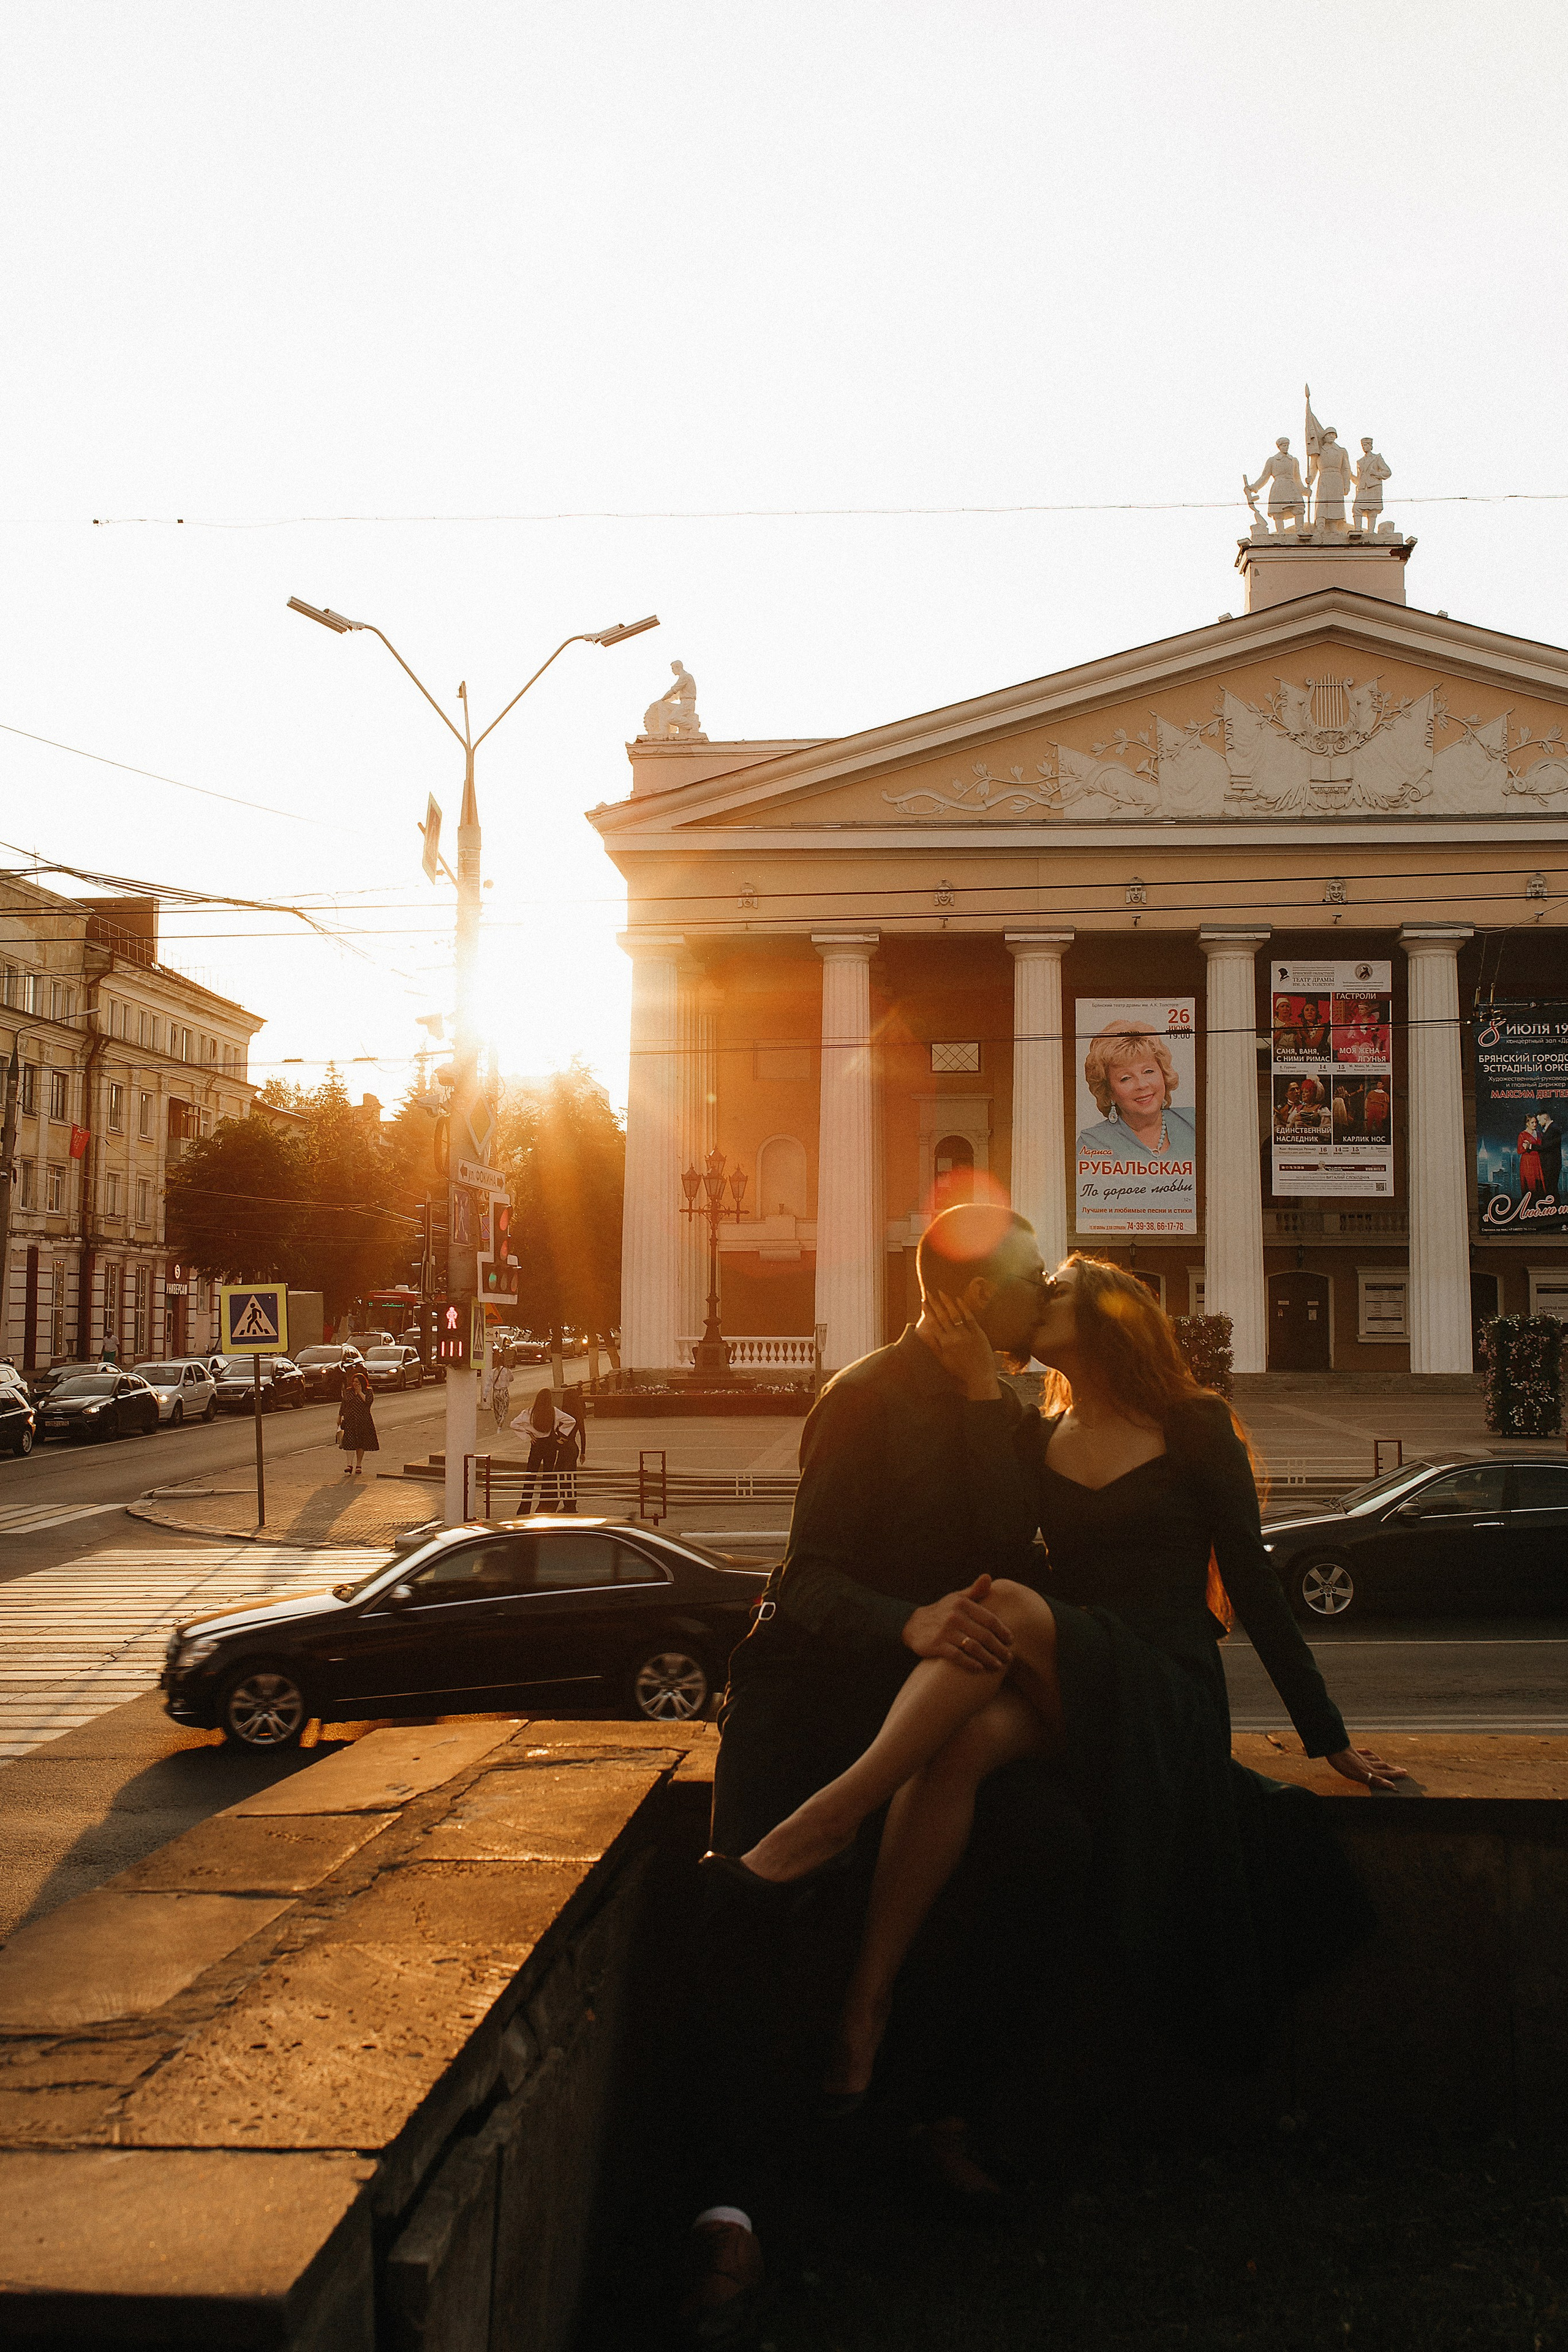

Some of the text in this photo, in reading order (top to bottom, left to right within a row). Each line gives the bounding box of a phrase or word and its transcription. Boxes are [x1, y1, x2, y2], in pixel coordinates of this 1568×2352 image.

[1168, 1009, 1190, 1023] 26
[1506, 1023, 1550, 1035] ИЮЛЯ
[1479, 1053, 1530, 1063] БРЯНСКИЙ
[1483, 1062, 1542, 1073] ЭСТРАДНЫЙ
[1490, 1090, 1535, 1099] МАКСИМ
[1079, 1145, 1112, 1158] Лариса
[1079, 1161, 1193, 1175] РУБАЛЬСКАЯ
[475, 1170, 497, 1187] ФОКИНА
[1080, 1178, 1193, 1200] По дороге любви
[1127, 1222, 1156, 1231] 74-39-38,
[1157, 1222, 1184, 1231] 66-17-78
